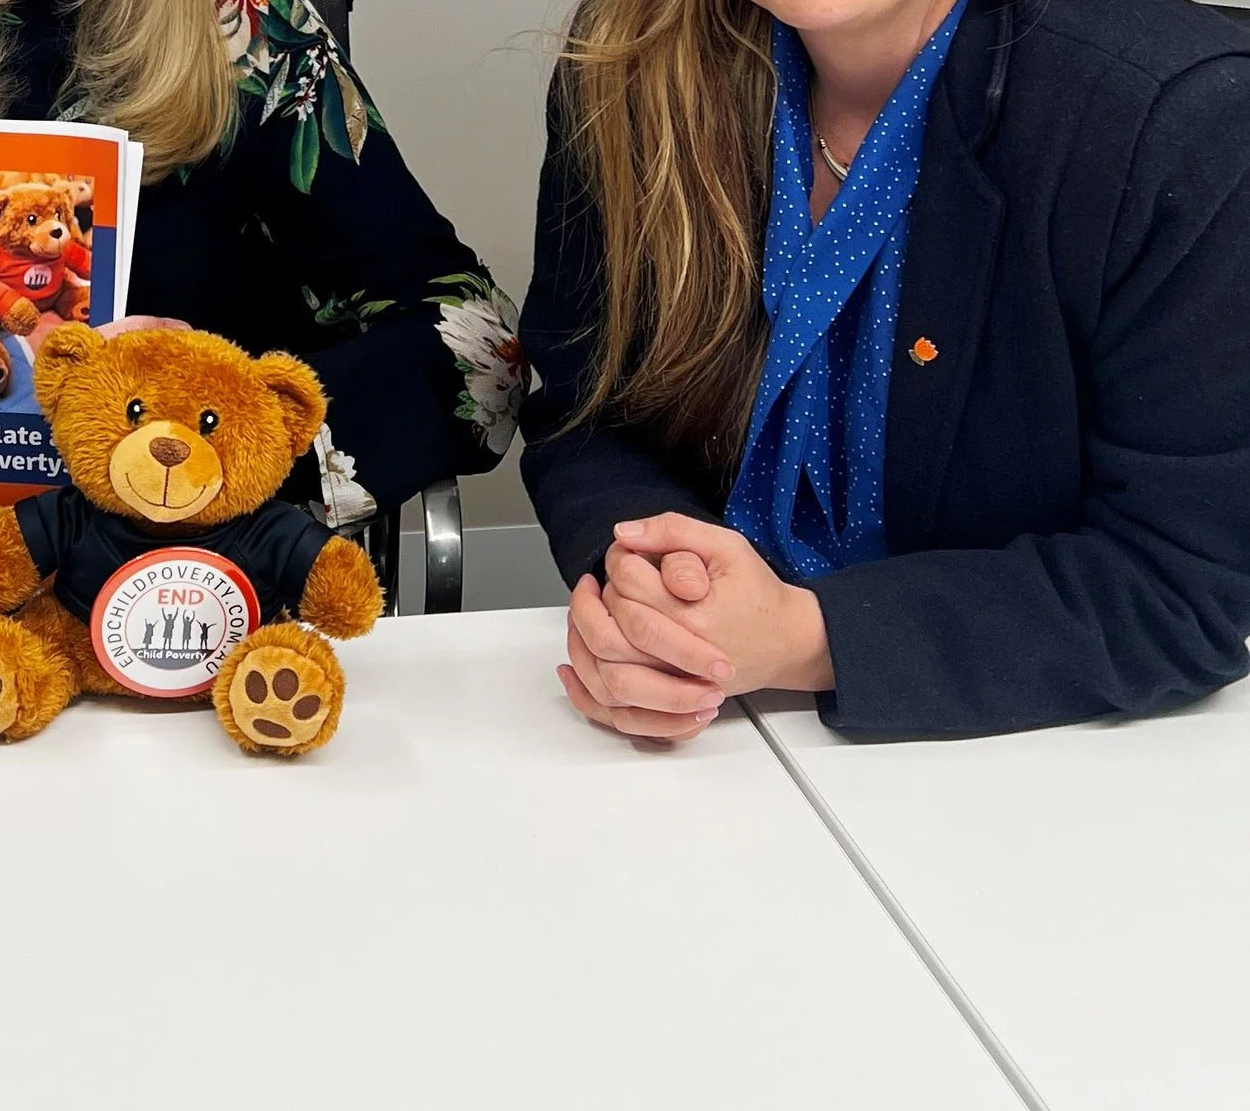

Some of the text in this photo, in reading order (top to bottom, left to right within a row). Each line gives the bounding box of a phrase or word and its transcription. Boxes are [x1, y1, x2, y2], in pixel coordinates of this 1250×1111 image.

[157, 589, 205, 606] END
[107, 565, 245, 674] ENDCHILDPOVERTY.COM.AU
[136, 649, 207, 661] Child Poverty
